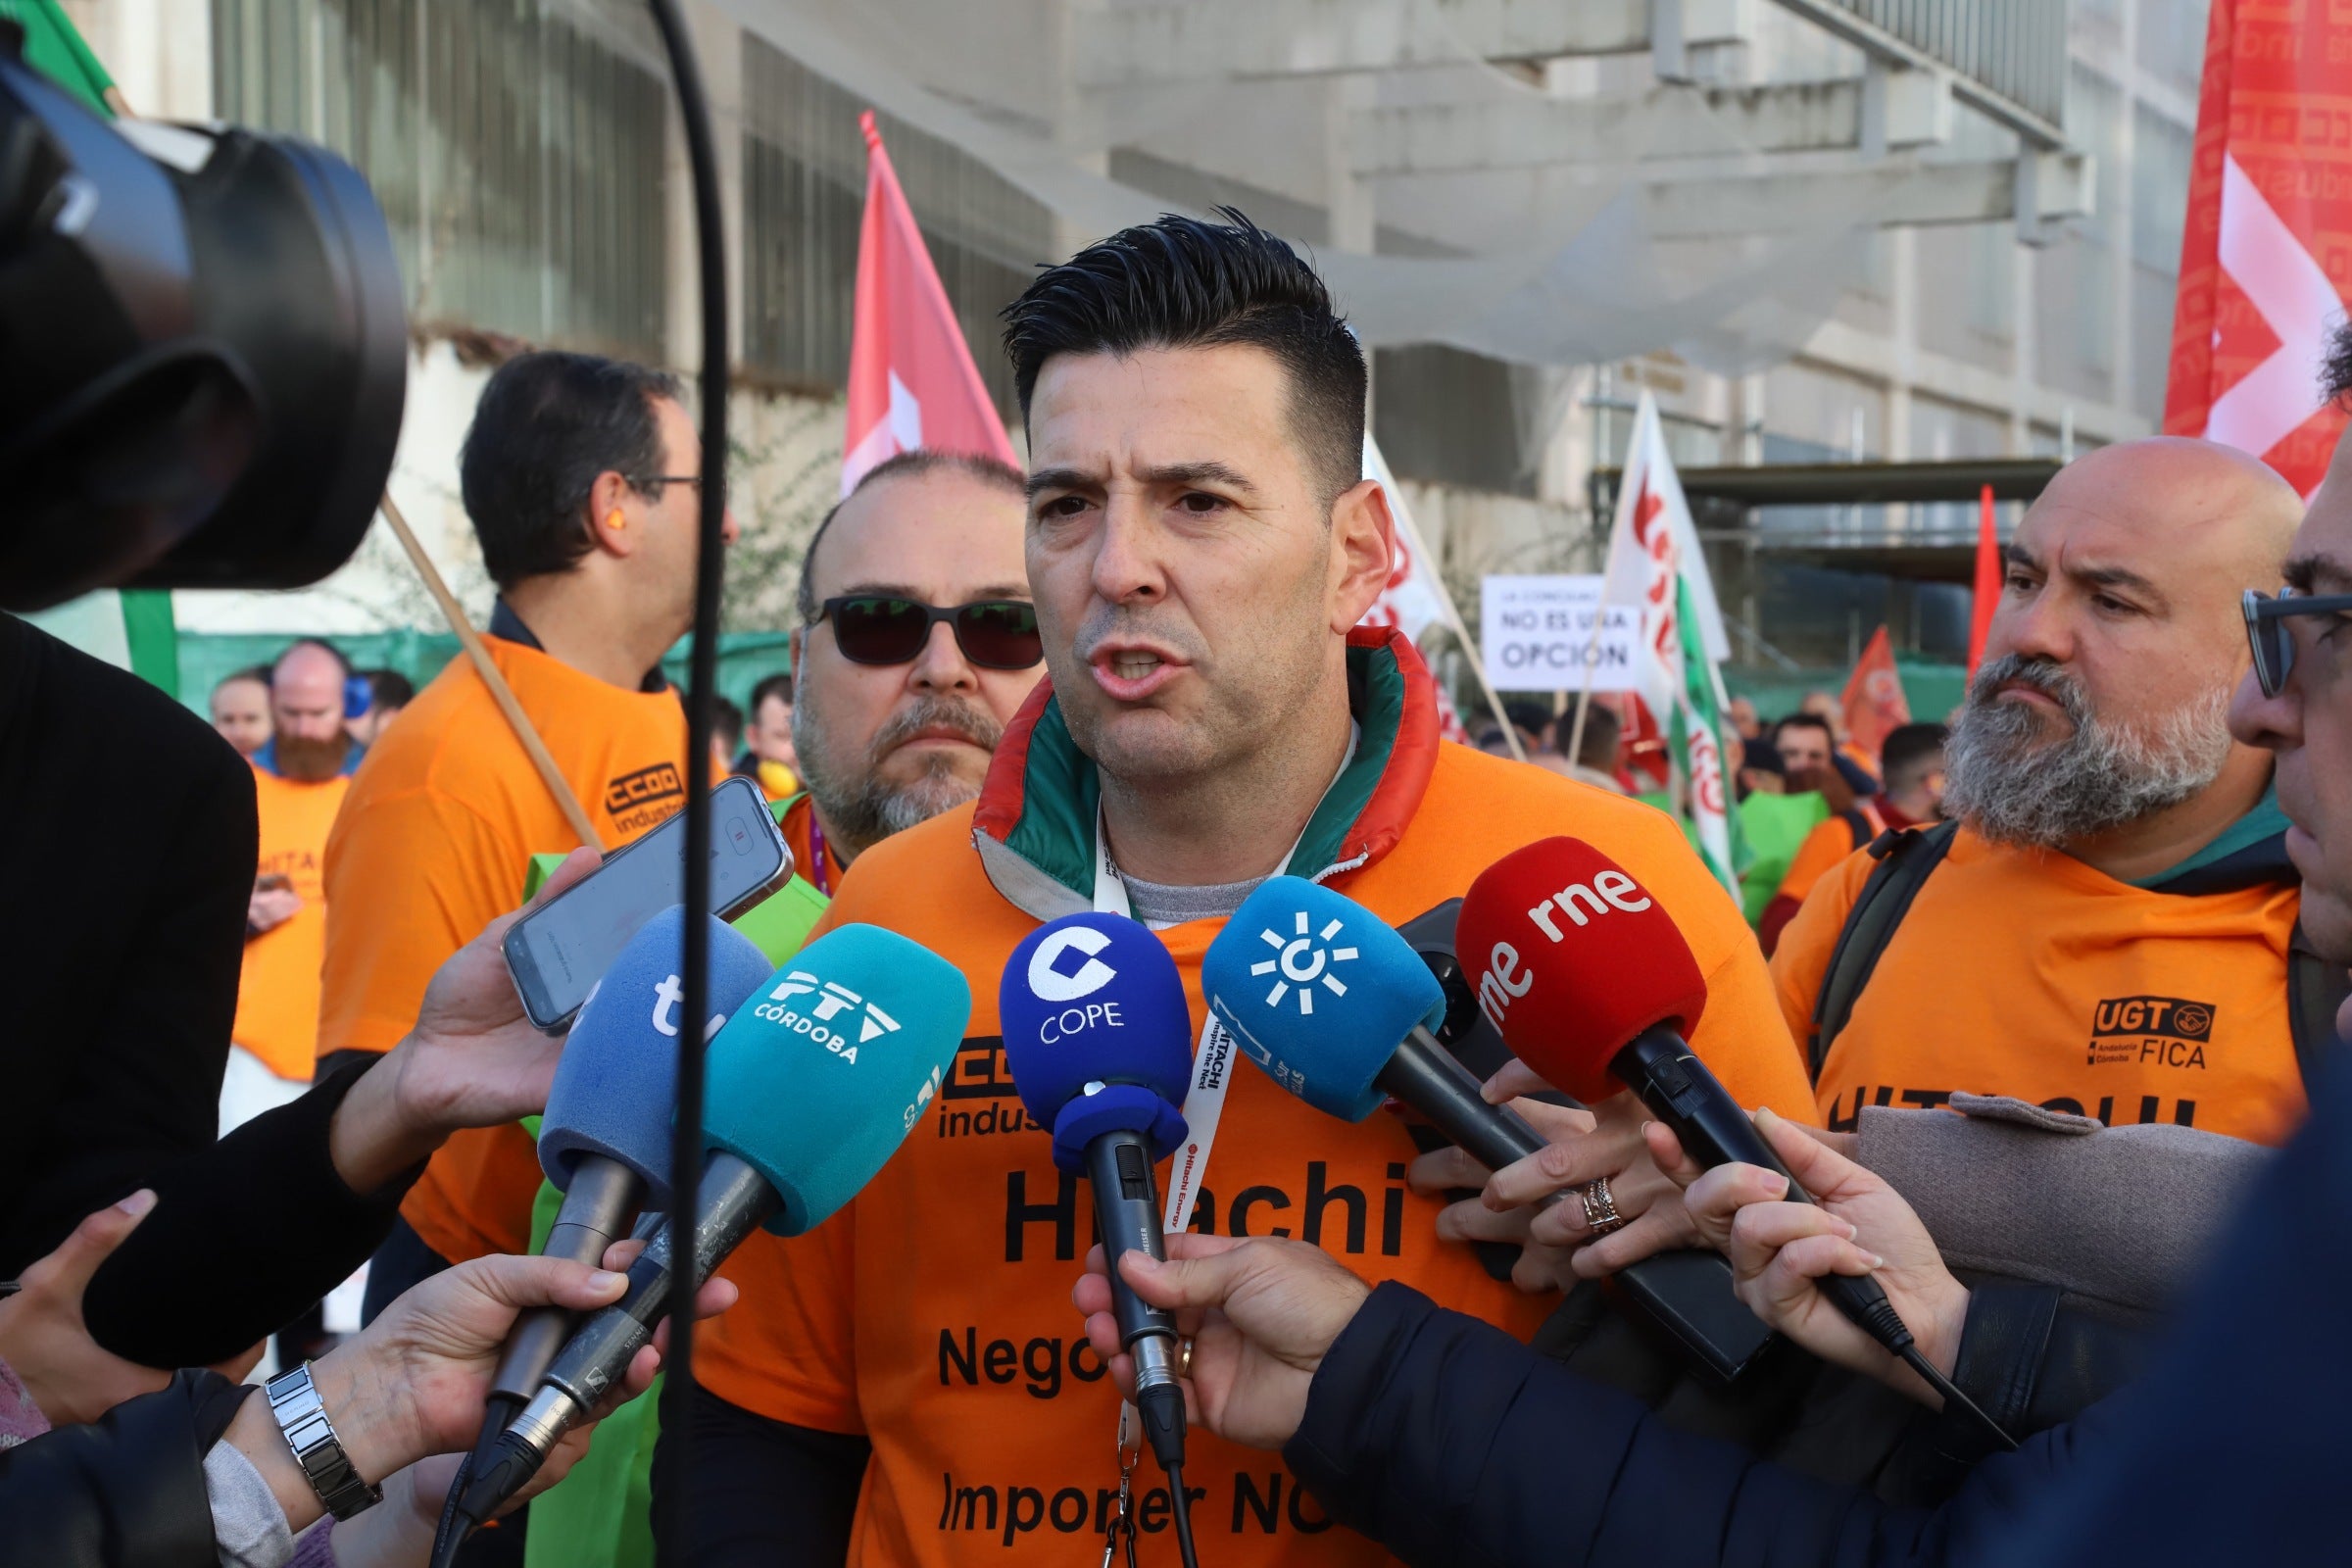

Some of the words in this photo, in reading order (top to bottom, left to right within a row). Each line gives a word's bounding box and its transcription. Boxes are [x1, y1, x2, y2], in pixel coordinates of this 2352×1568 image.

[1501, 612, 1539, 631] NO
[1546, 612, 1569, 630] ES
[607, 765, 680, 812] CCOO
[1527, 869, 1652, 944] rne
[768, 970, 902, 1044] PTV
[1040, 1003, 1125, 1044] COPE
[2096, 1000, 2173, 1032] UGT
[754, 1003, 858, 1065] CÓRDOBA
[1203, 1053, 1215, 1066] the
[2139, 1039, 2206, 1070] FICA
[1198, 1068, 1211, 1090] Next
[1180, 1154, 1195, 1191] Hitachi
[1172, 1192, 1187, 1229] Energy
